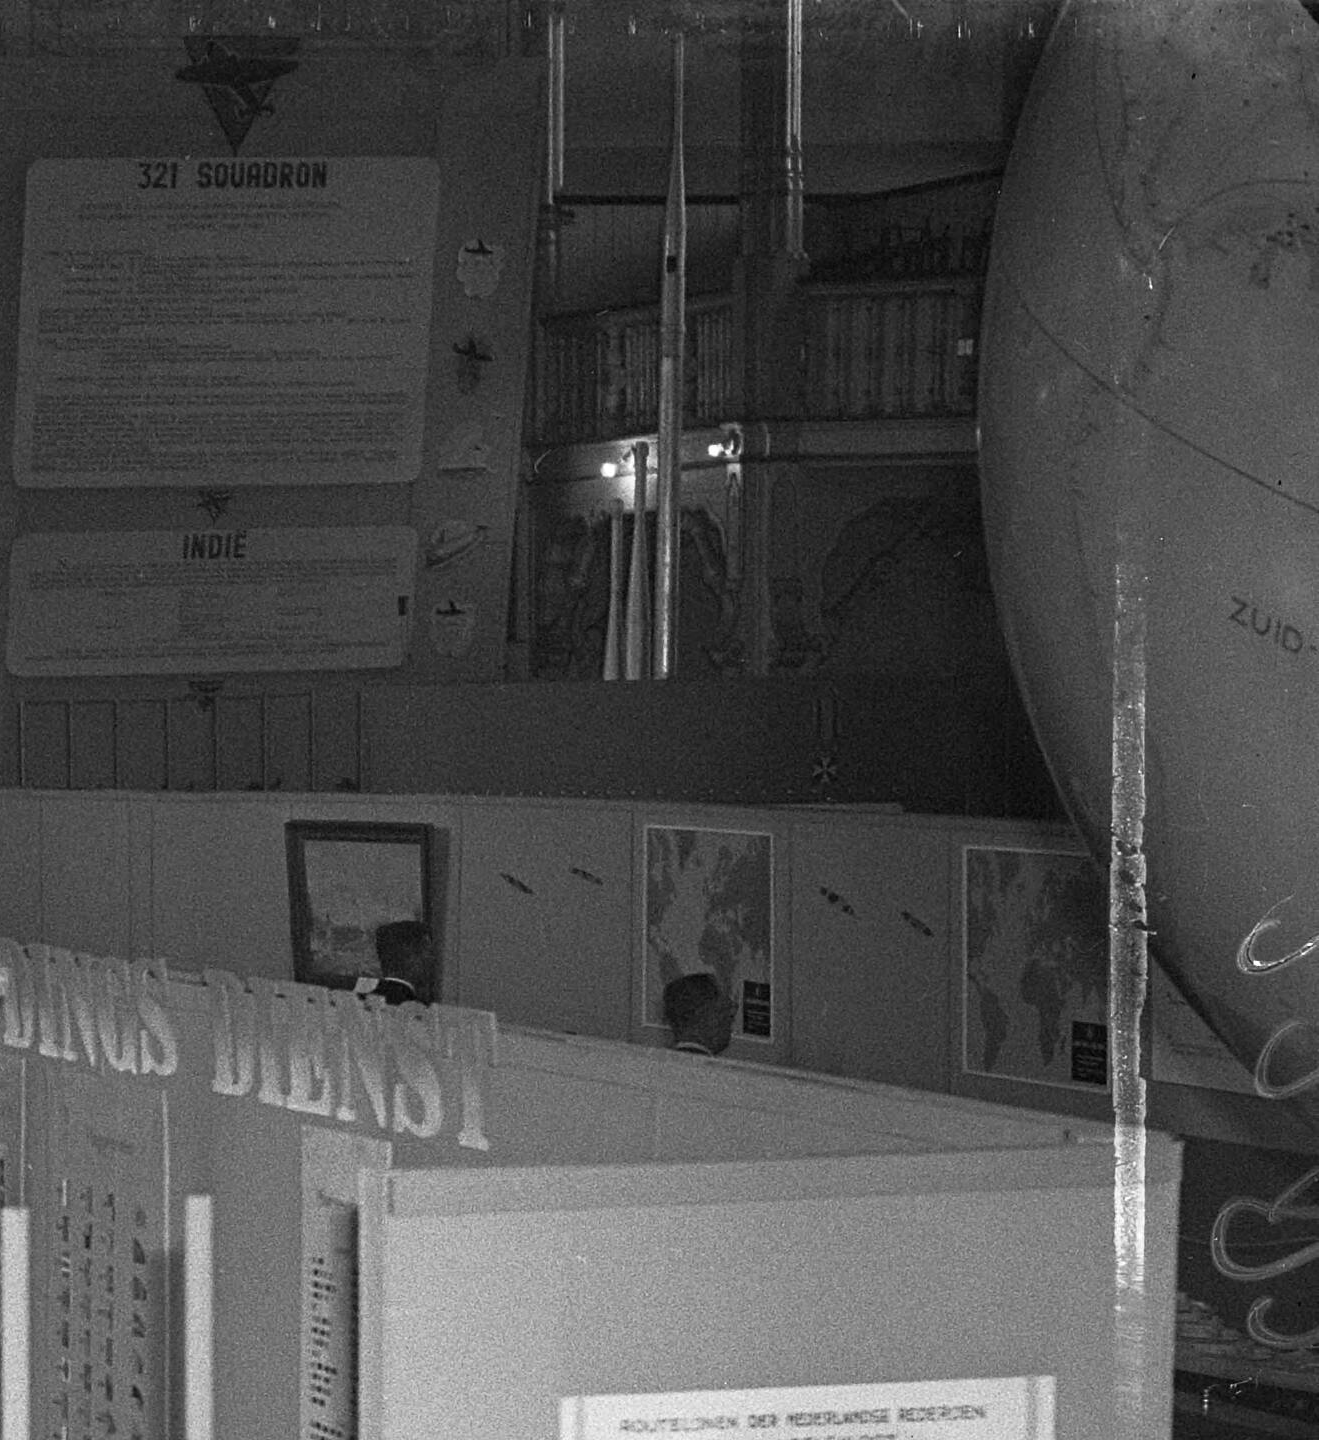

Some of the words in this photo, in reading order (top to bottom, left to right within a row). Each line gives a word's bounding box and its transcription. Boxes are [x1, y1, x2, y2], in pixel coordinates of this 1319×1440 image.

[137, 162, 178, 190] 321
[195, 161, 328, 189] SQUADRON
[202, 969, 498, 1152] DIENST
[747, 1413, 777, 1429] DER
[787, 1408, 891, 1427] NEDERLANDSE
